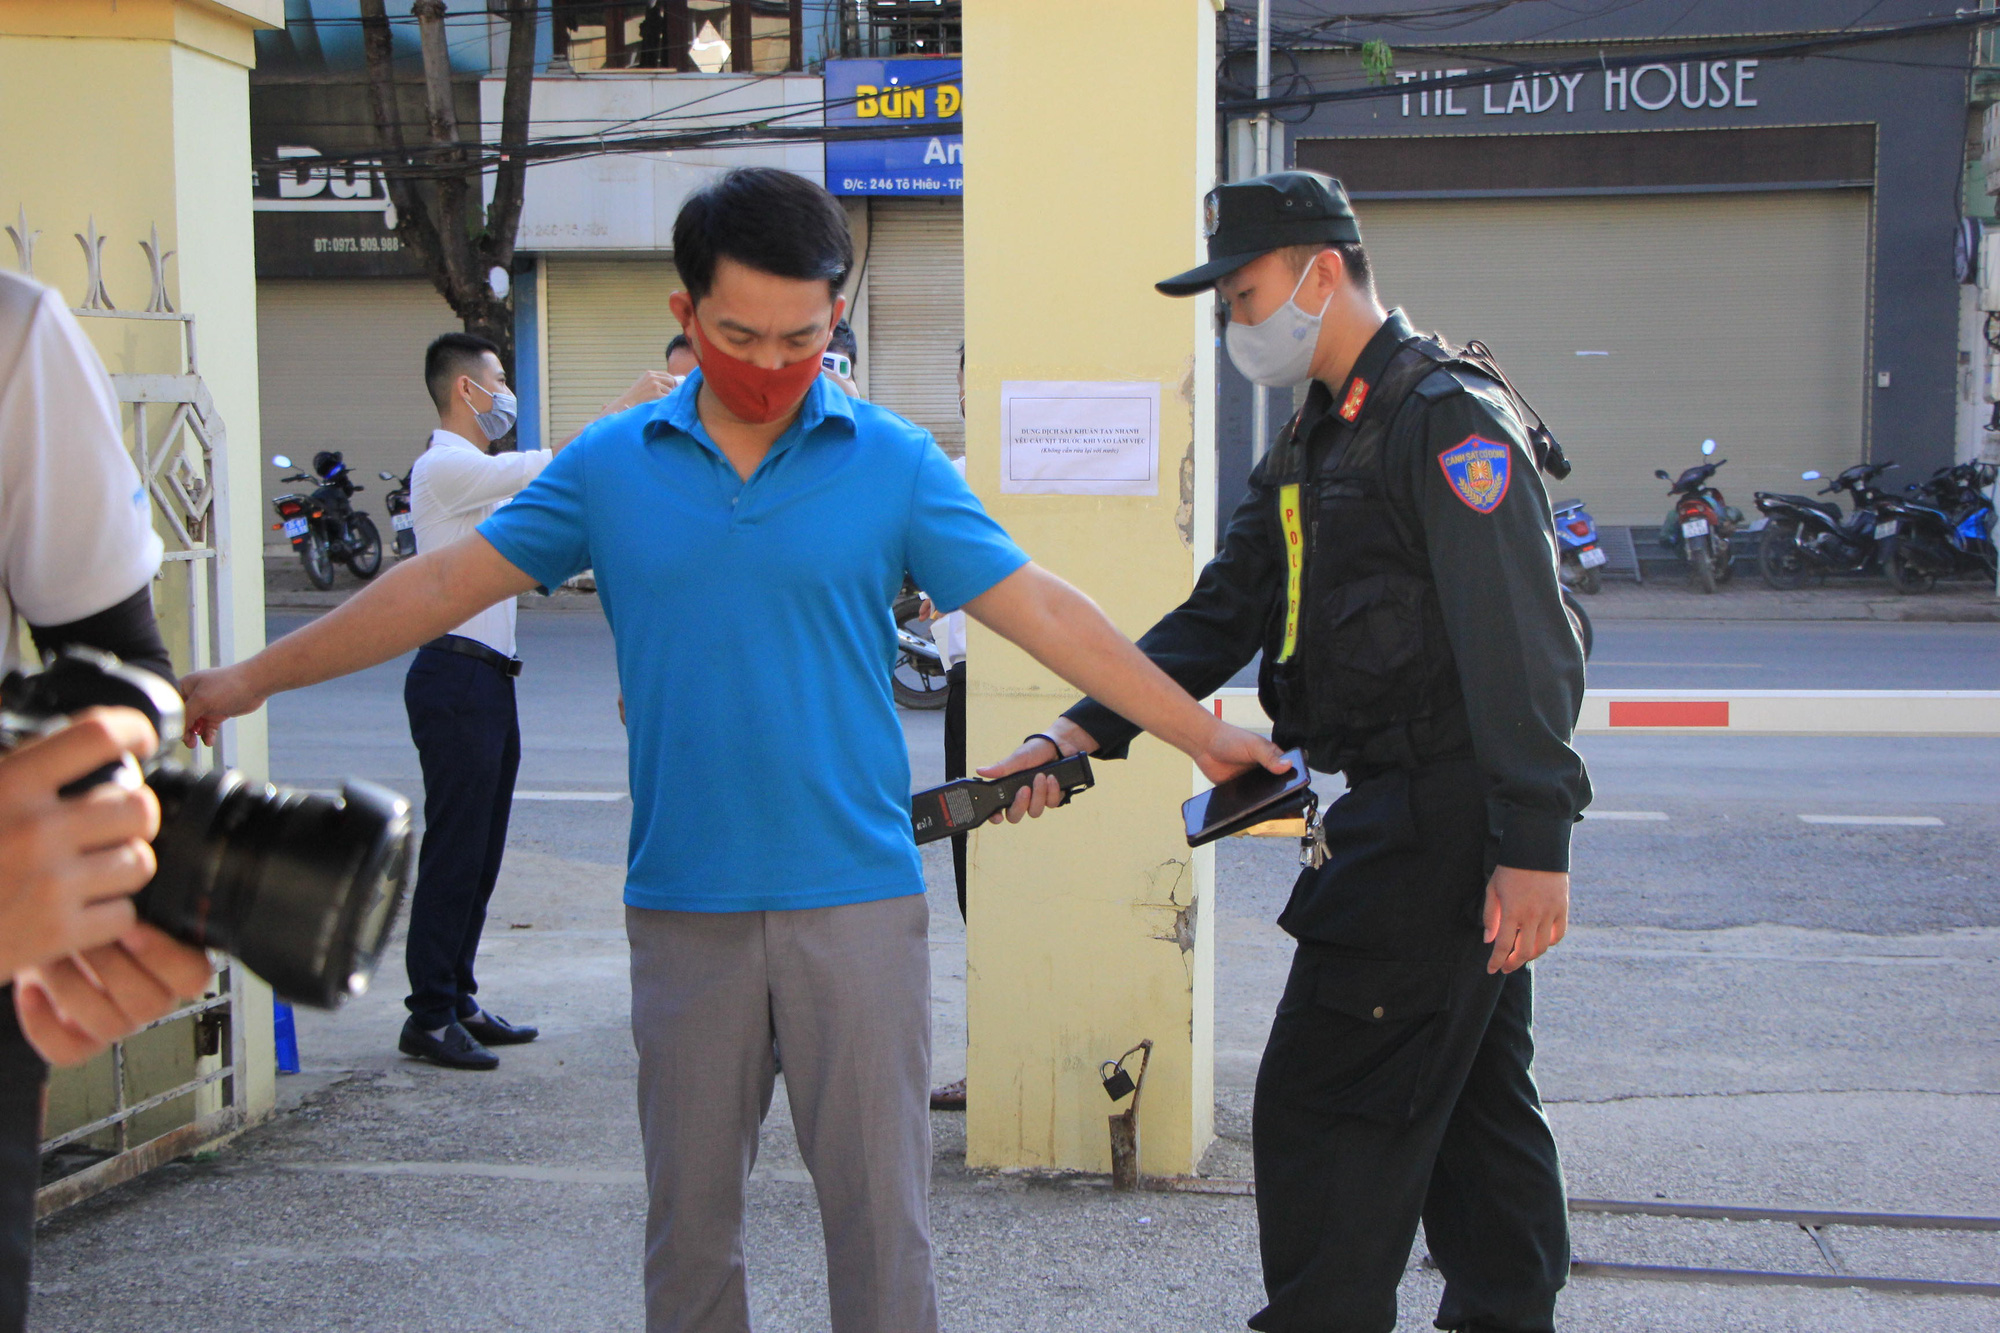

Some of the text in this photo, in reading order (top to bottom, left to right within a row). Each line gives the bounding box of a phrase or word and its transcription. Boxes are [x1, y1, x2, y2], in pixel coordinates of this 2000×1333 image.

[1395, 60, 1759, 117] THE LADY HOUSE
[870, 178, 894, 190] 246
[1100, 427, 1114, 435] TAY
[1115, 427, 1139, 435] NHANH
[1285, 508, 1299, 637] POLICE
